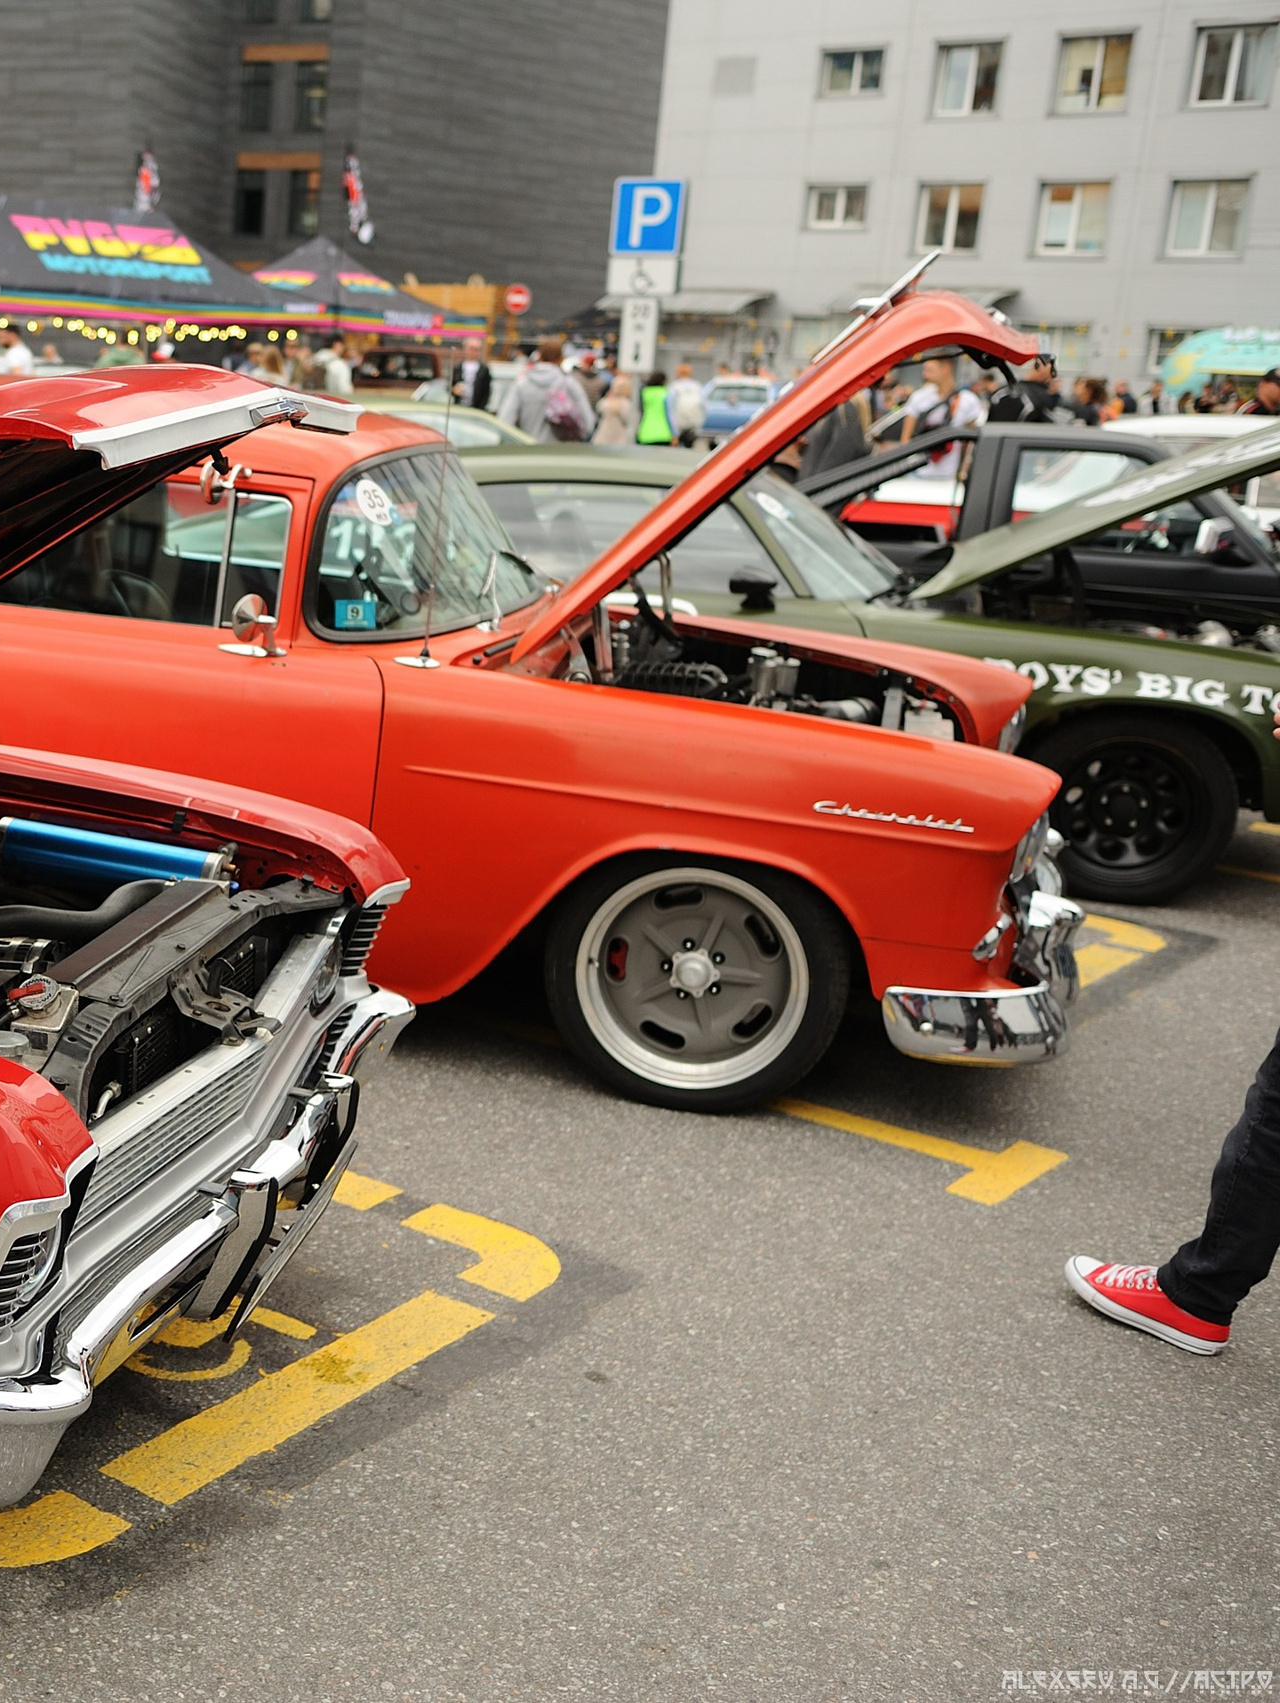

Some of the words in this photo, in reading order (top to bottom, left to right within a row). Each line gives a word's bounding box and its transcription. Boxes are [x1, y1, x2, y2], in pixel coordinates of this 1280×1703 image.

[629, 186, 672, 248] P
[363, 489, 385, 509] 35
[1135, 670, 1231, 708] BIG
[1240, 684, 1280, 715] T
[812, 800, 975, 834] Chevrolet
